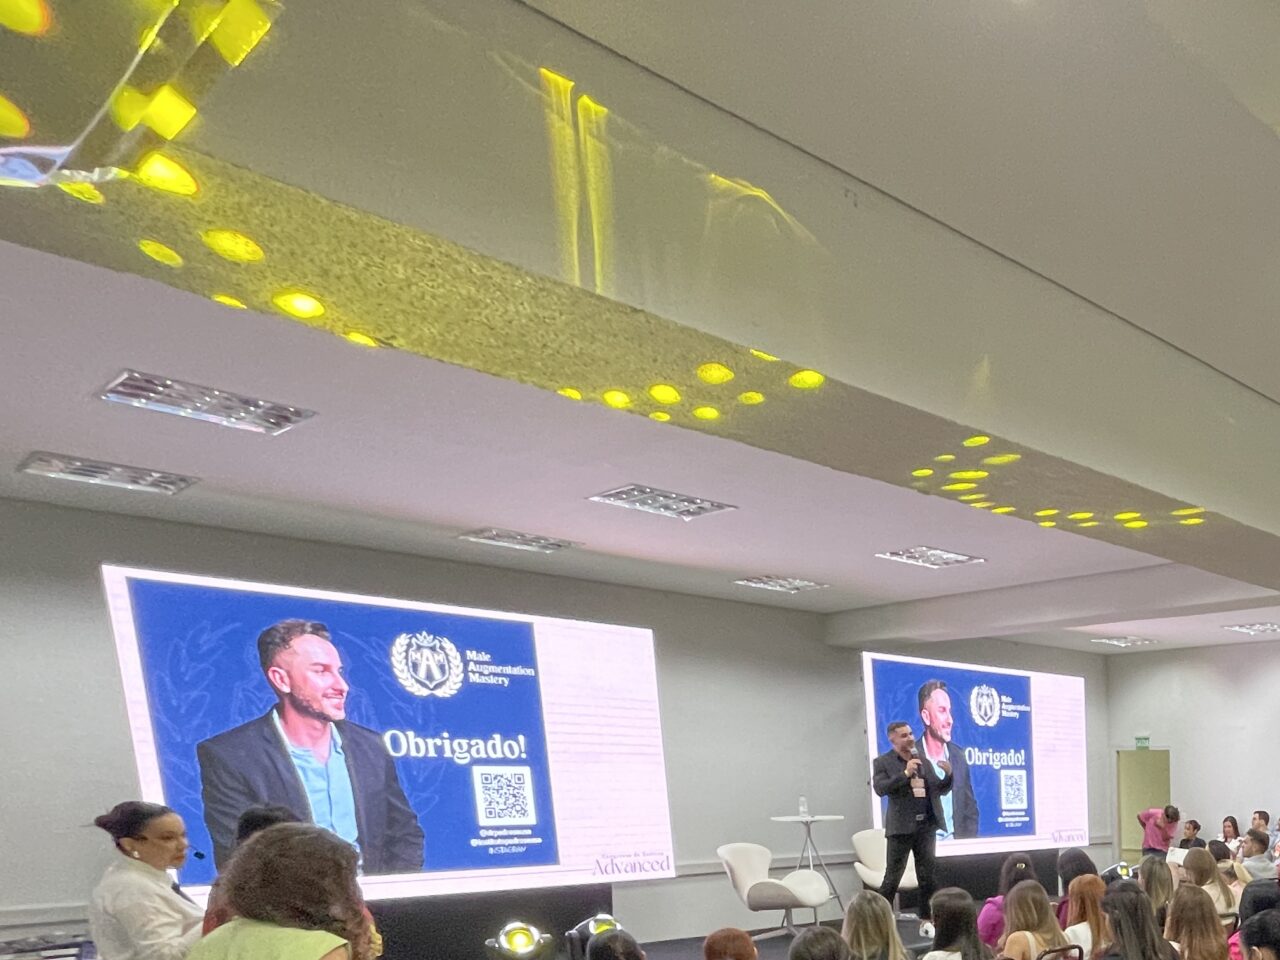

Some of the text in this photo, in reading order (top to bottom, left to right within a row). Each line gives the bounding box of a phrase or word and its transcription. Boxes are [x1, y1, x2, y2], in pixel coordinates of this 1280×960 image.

[466, 650, 492, 661] Male
[468, 662, 535, 676] Augmentation
[469, 673, 510, 687] Mastery
[384, 729, 527, 764] Obrigado!
[964, 747, 1026, 770] Obrigado!
[592, 855, 670, 876] Advanced
